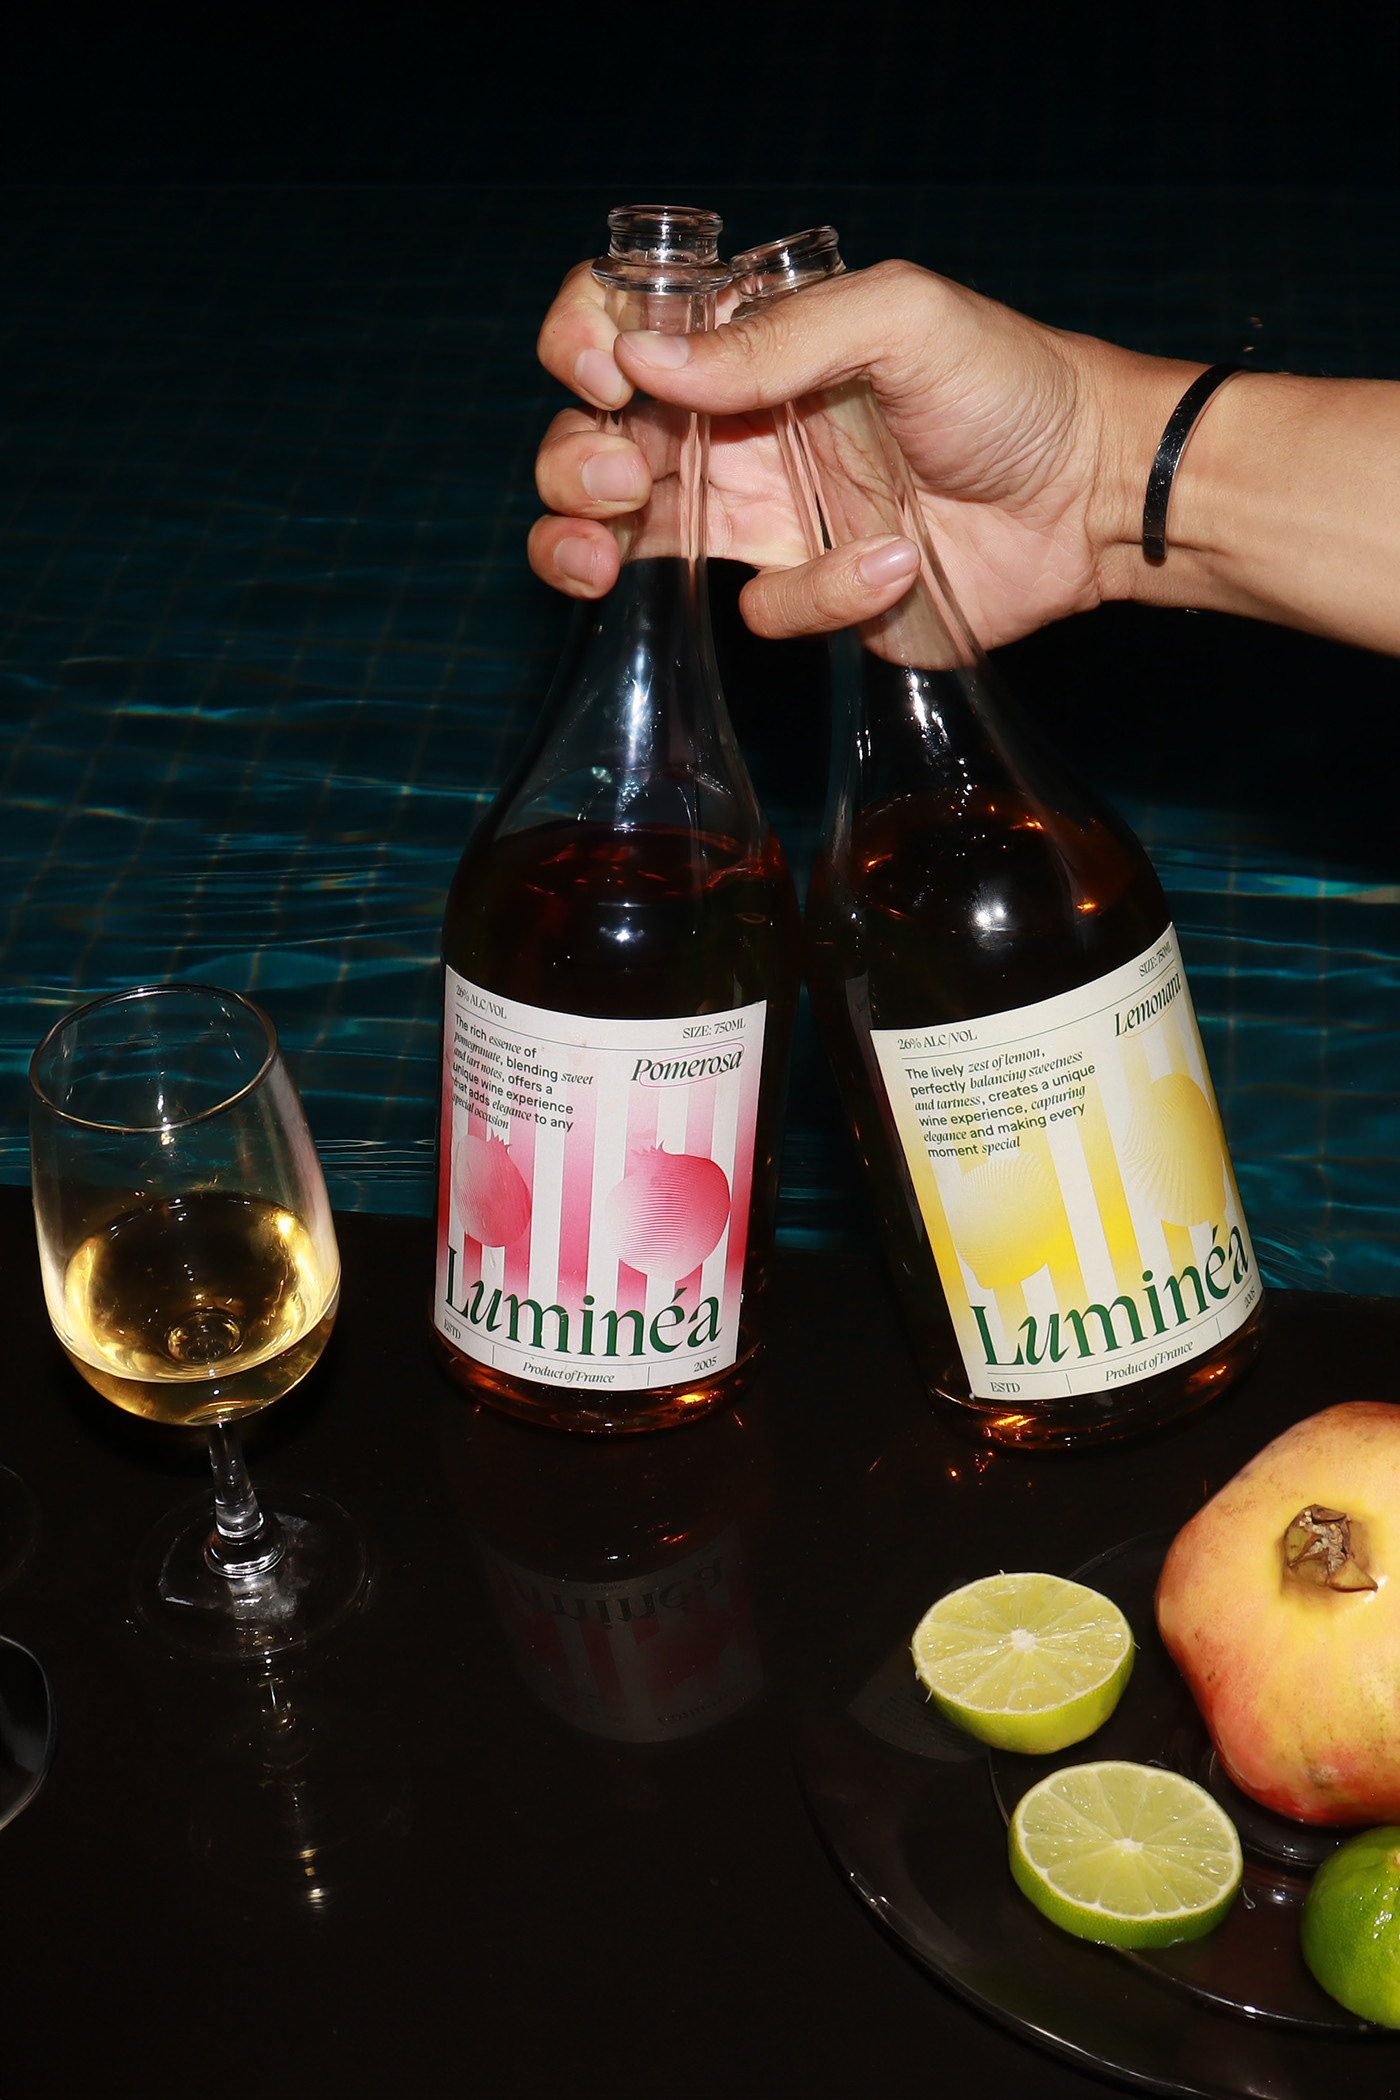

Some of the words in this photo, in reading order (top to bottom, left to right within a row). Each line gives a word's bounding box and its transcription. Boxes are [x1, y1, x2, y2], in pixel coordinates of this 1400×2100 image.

[456, 1014, 468, 1032] The
[470, 1024, 487, 1042] rich
[489, 1035, 522, 1054] essence
[524, 1048, 537, 1059] of
[682, 1024, 712, 1039] SIZE:
[714, 1018, 746, 1034] 750ML
[898, 1037, 922, 1050] 26%
[453, 1048, 466, 1062] and
[466, 1053, 480, 1070] tart
[481, 1062, 505, 1082] notes,
[507, 1074, 542, 1092] offers
[545, 1084, 553, 1095] a
[454, 1032, 503, 1066] pomegranate,
[506, 1056, 558, 1082] blending
[561, 1072, 594, 1085] sweet
[630, 1050, 743, 1082] Pomerosa
[905, 1068, 928, 1080] The
[931, 1063, 964, 1078] lively
[968, 1059, 989, 1073] zest
[992, 1054, 1004, 1073] of
[1004, 1047, 1045, 1064] lemon,
[910, 1081, 966, 1098] perfectly
[970, 1069, 1027, 1090] balancing
[1029, 1051, 1083, 1077] sweetness
[452, 1062, 479, 1085] unique
[481, 1078, 504, 1096] wine
[506, 1088, 574, 1114] experience
[454, 1077, 468, 1093] that
[468, 1088, 490, 1106] adds
[492, 1100, 532, 1121] elegance
[534, 1113, 547, 1125] to
[550, 1119, 574, 1133] any
[915, 1099, 935, 1112] and
[937, 1095, 985, 1111] tartness,
[988, 1084, 1039, 1103] creates
[1041, 1080, 1050, 1090] a
[1052, 1064, 1096, 1087] unique
[919, 1115, 948, 1127] wine
[950, 1103, 1028, 1126] experience,
[1031, 1085, 1086, 1112] capturing
[452, 1093, 474, 1113] special
[474, 1108, 509, 1130] occasion
[923, 1130, 967, 1145] elegance
[970, 1125, 994, 1139] and
[998, 1115, 1047, 1134] making
[1049, 1103, 1085, 1123] every
[928, 1144, 978, 1158] moment
[982, 1136, 1020, 1156] special
[445, 1244, 722, 1357] Luminéa
[970, 1224, 1249, 1366] Luminéa
[523, 1362, 563, 1379] Product
[565, 1370, 577, 1383] of
[576, 1372, 615, 1384] France
[693, 1356, 717, 1373] 2005
[1105, 1360, 1147, 1382] Product
[1148, 1353, 1160, 1371] of
[1160, 1341, 1193, 1364] France
[990, 1382, 1021, 1394] ESTD
